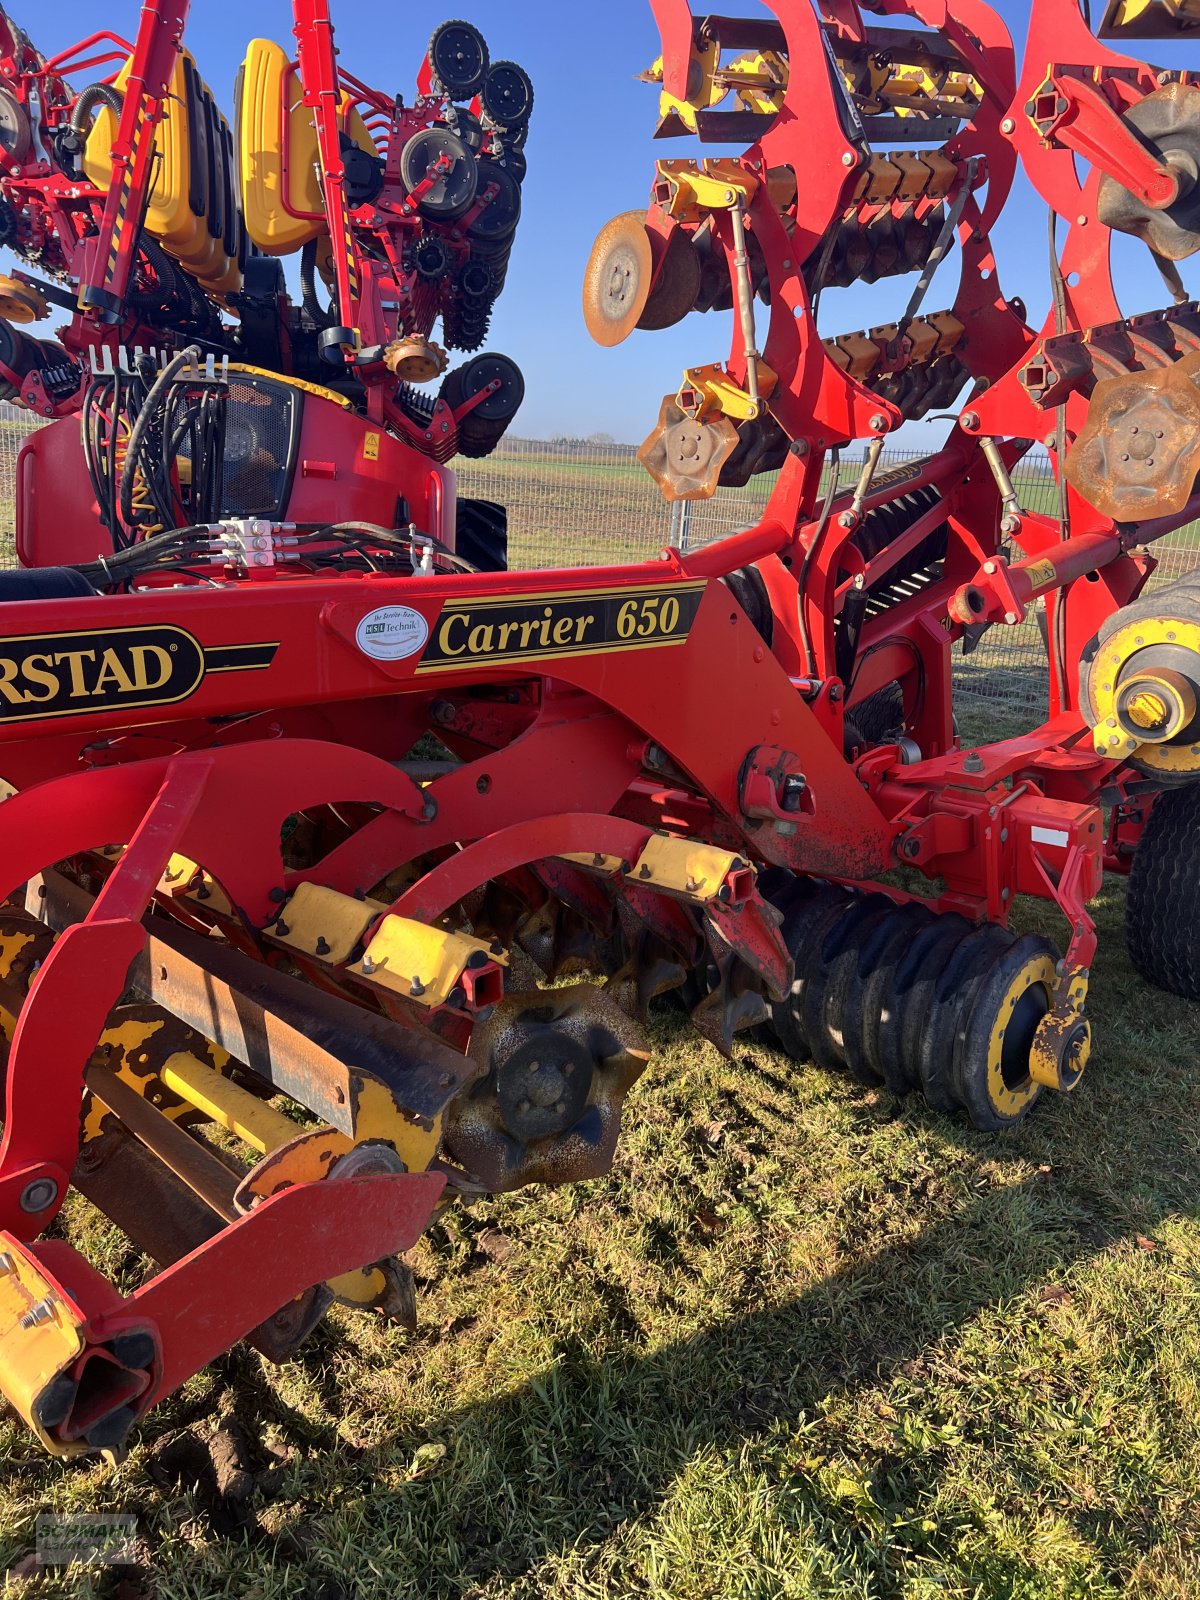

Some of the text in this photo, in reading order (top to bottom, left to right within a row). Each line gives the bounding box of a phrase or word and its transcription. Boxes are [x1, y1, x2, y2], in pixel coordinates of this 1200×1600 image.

[387, 620, 417, 632] Technik
[438, 596, 680, 656] Carrier 650
